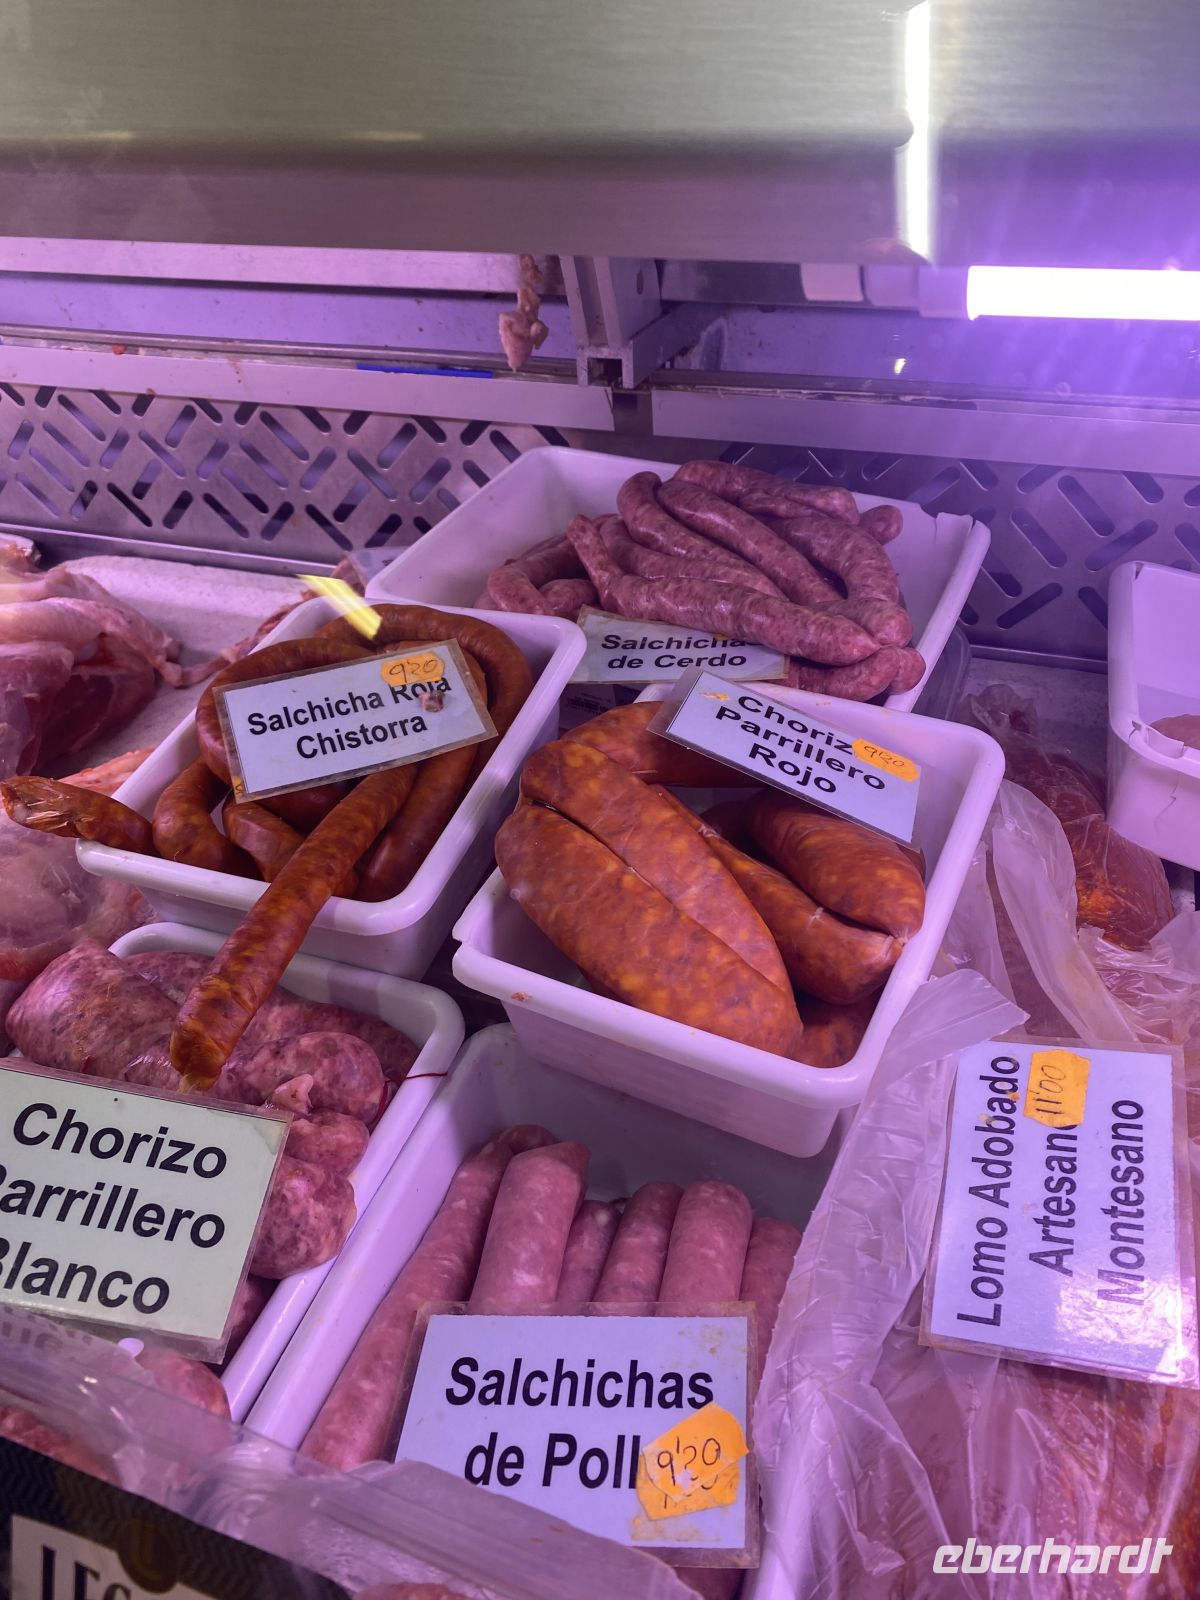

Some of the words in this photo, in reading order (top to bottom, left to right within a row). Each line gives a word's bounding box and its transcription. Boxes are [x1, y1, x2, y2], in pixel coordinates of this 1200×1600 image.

[601, 634, 760, 650] Salchicha
[607, 655, 644, 669] de
[654, 653, 747, 668] Cerdo
[247, 686, 385, 735] Salchicha
[296, 715, 428, 759] Chistorra
[738, 695, 853, 756] Choriz
[715, 706, 885, 790] Parrillero
[749, 743, 837, 793] Rojo
[13, 1102, 227, 1179] Chorizo
[968, 1056, 1020, 1208] Adobado
[1029, 1124, 1078, 1278] Artesan
[1097, 1099, 1145, 1306] Montesano
[957, 1216, 1008, 1327] Lomo
[445, 1356, 714, 1410] Salchichas
[464, 1432, 525, 1487] de
[542, 1432, 641, 1489] Poll
